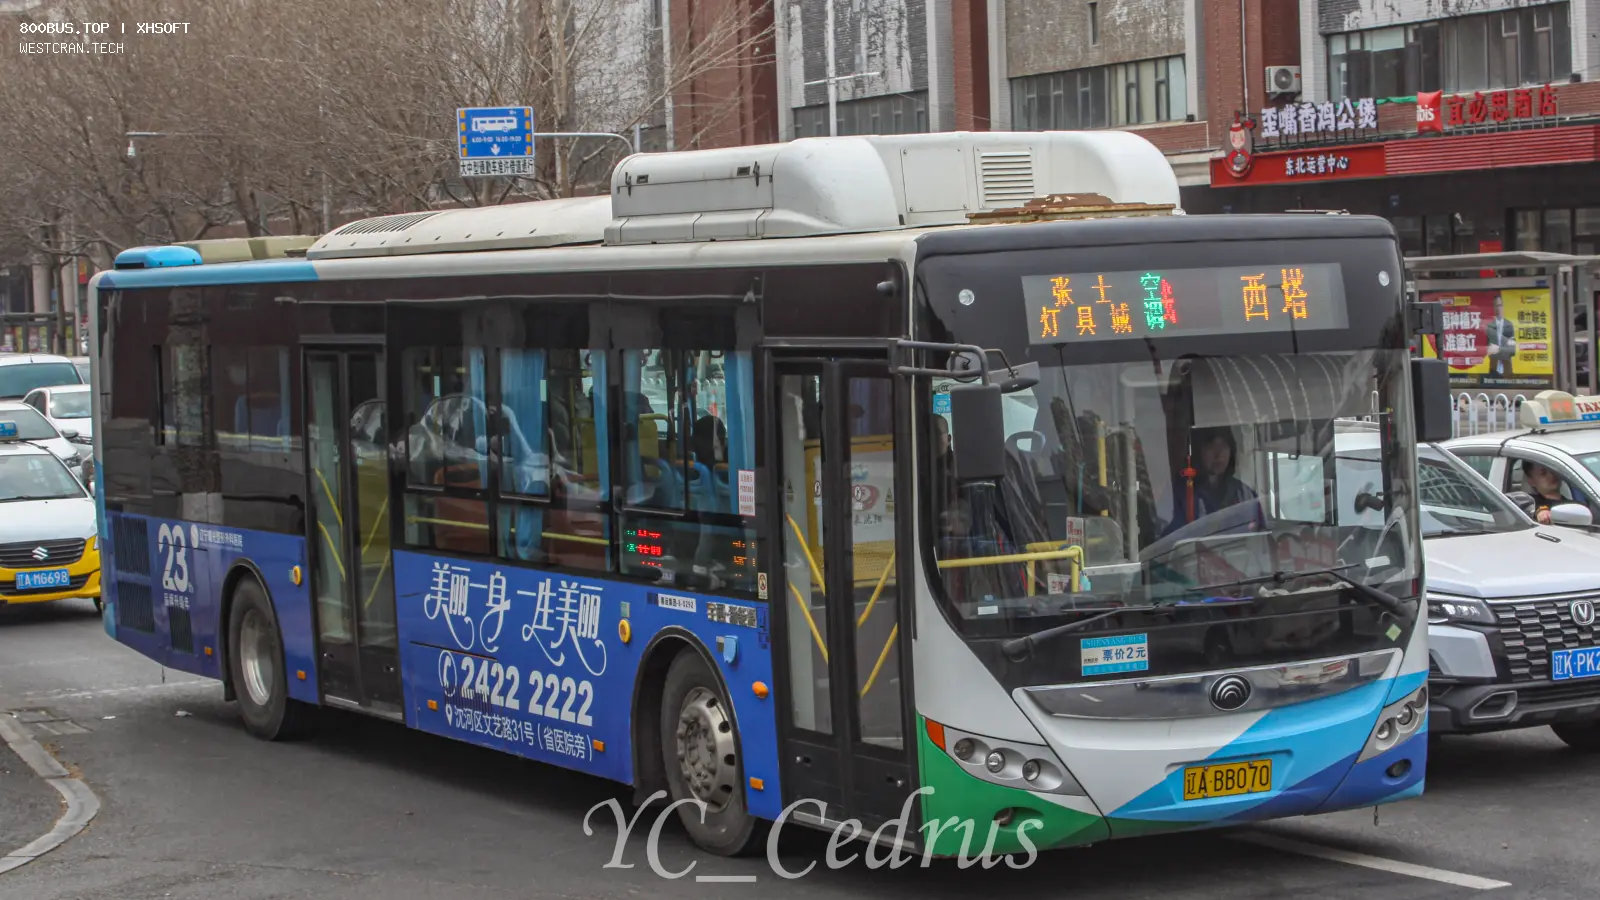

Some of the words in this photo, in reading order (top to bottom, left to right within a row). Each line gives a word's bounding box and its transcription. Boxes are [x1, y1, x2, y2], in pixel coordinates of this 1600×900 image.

[1260, 97, 1378, 139] 歪嘴香鸡公煲
[1416, 104, 1435, 122] ibis
[1446, 84, 1558, 126] 宜必思酒店
[1285, 155, 1350, 177] 东北运营中心
[1140, 272, 1165, 330] 空调
[1240, 268, 1308, 321] 西塔
[158, 523, 188, 592] 23
[424, 562, 511, 653] 美丽一身
[517, 578, 607, 676] 一生美丽
[1102, 646, 1146, 662] 票价2元
[461, 656, 520, 710] 2422
[528, 670, 594, 727] 2222
